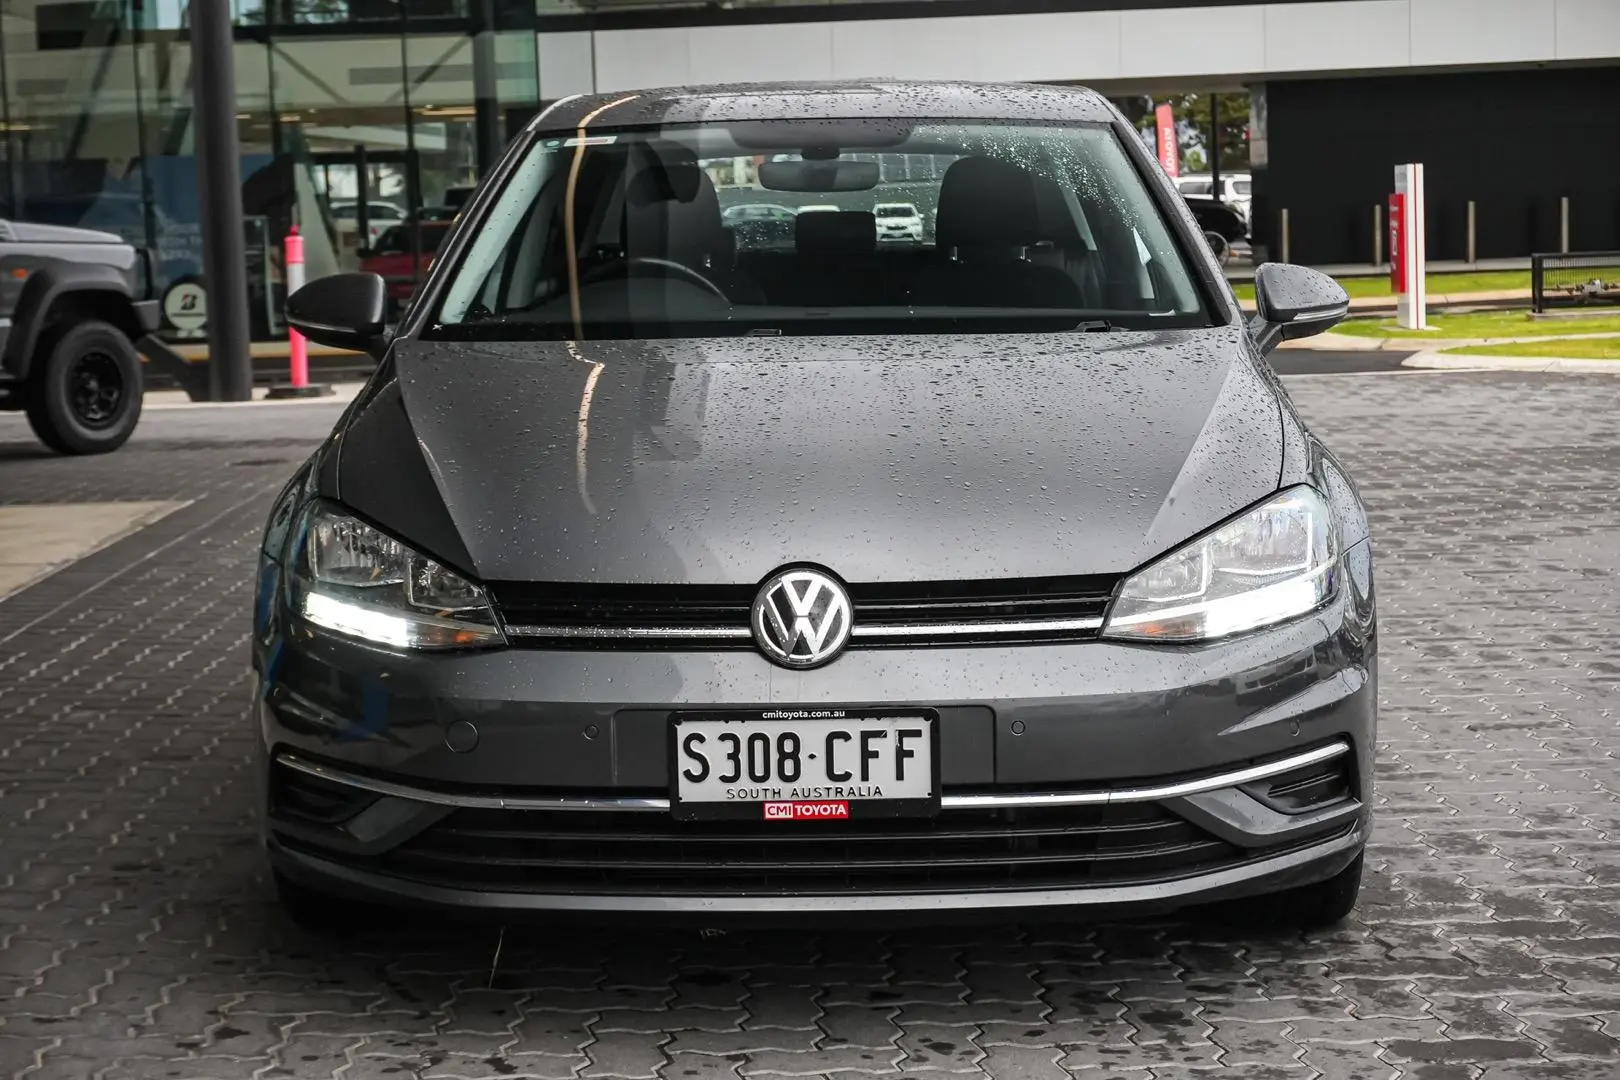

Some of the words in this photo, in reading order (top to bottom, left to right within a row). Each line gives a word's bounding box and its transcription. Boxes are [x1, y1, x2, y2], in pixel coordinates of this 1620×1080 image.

[762, 709, 846, 720] cmitoyota.com.au
[726, 787, 782, 799] SOUTH
[790, 785, 884, 799] AUSTRALIA
[766, 804, 792, 817] CMI
[794, 803, 847, 817] TOYOTA
